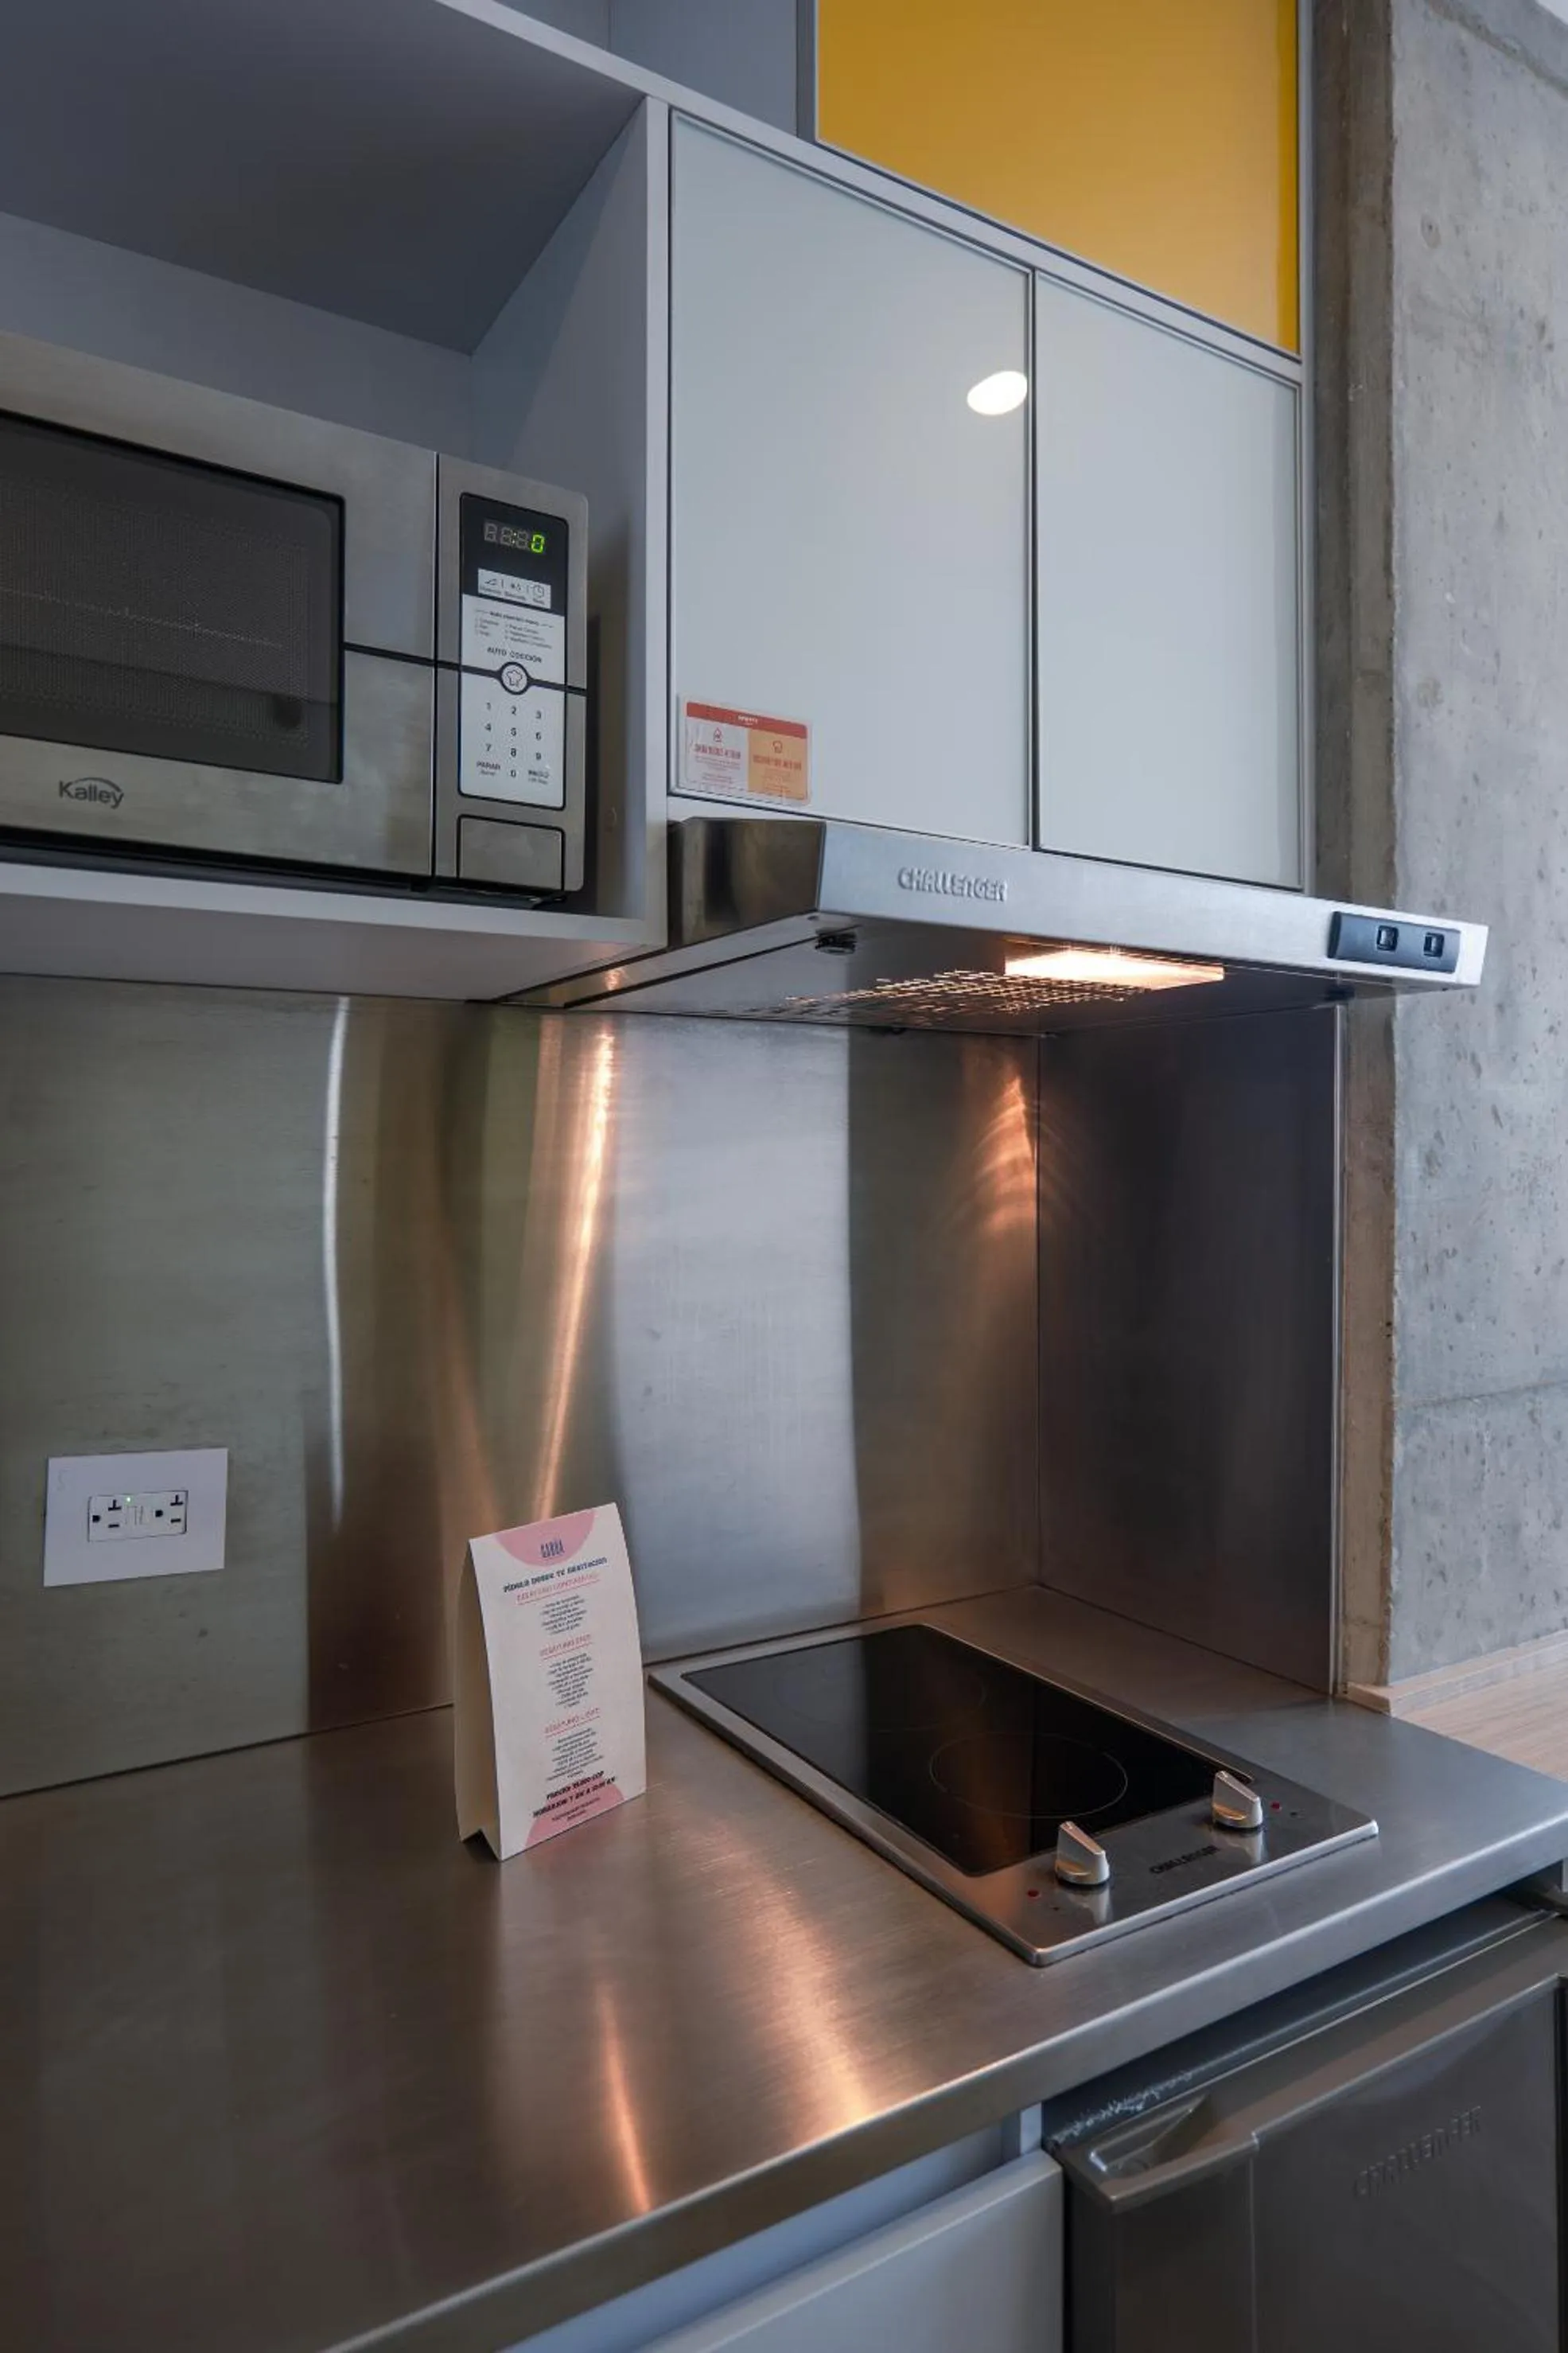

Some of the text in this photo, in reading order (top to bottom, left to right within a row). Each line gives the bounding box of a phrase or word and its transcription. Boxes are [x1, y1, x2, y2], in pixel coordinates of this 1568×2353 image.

[486, 702, 492, 711] 1
[512, 706, 517, 715] 2
[484, 723, 492, 732] 4
[511, 748, 516, 758] 8
[59, 777, 124, 809] Kalley
[897, 866, 1008, 902] CHALLENGER
